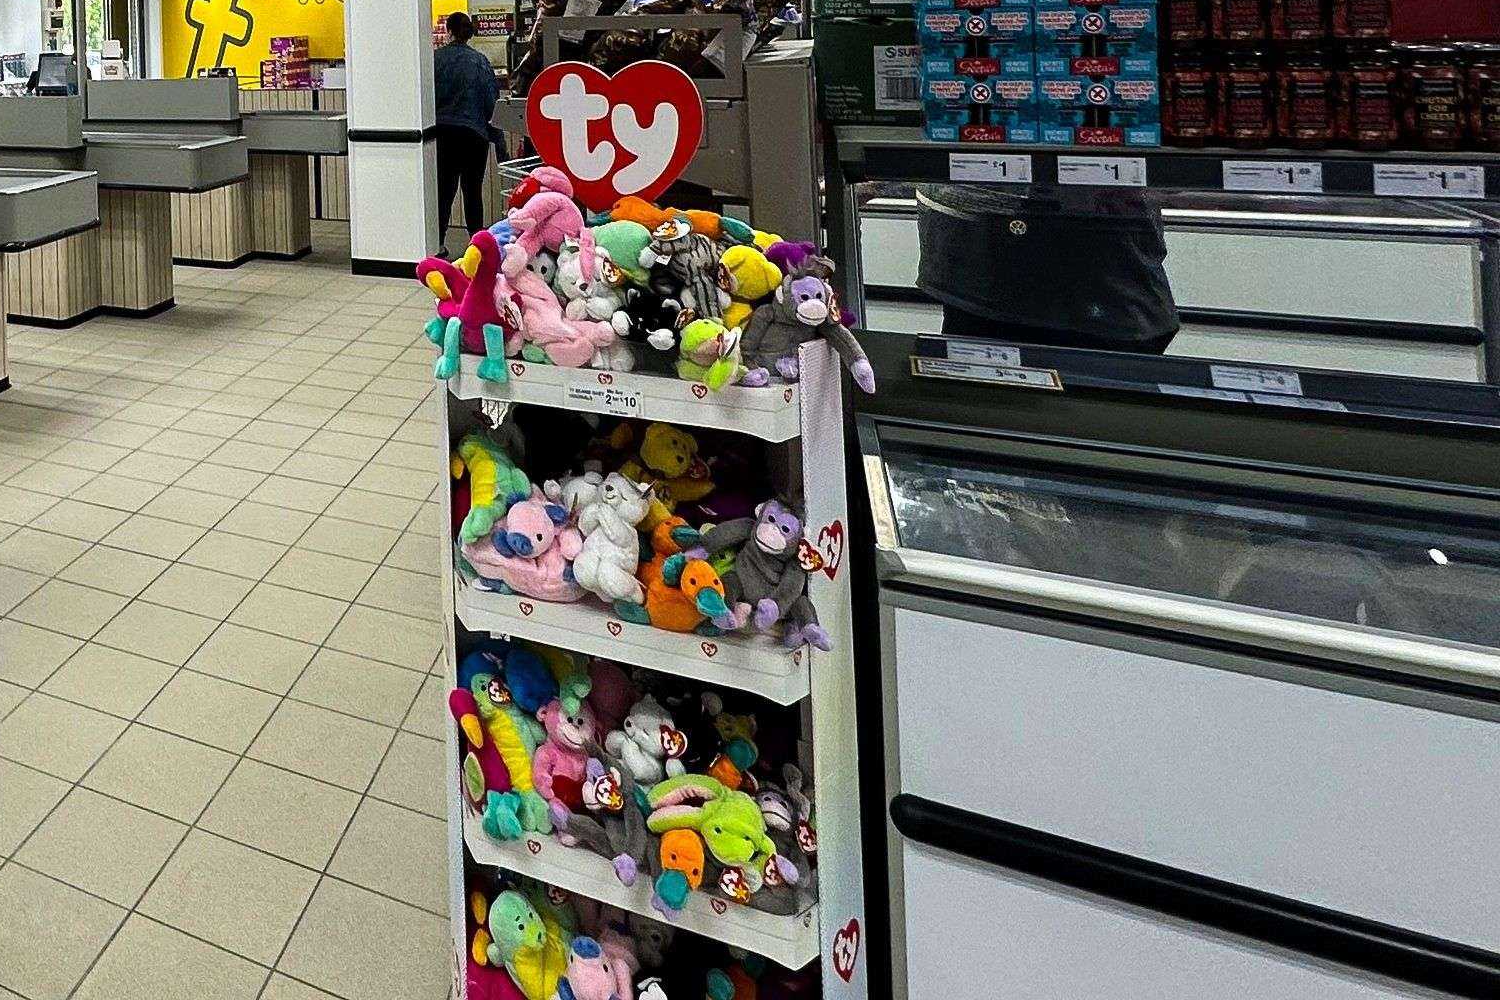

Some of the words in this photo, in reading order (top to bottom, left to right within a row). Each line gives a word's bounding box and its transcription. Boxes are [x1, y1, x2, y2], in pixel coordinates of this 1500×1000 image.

[540, 72, 679, 195] ty
[605, 394, 612, 405] 2
[834, 930, 858, 971] ty
